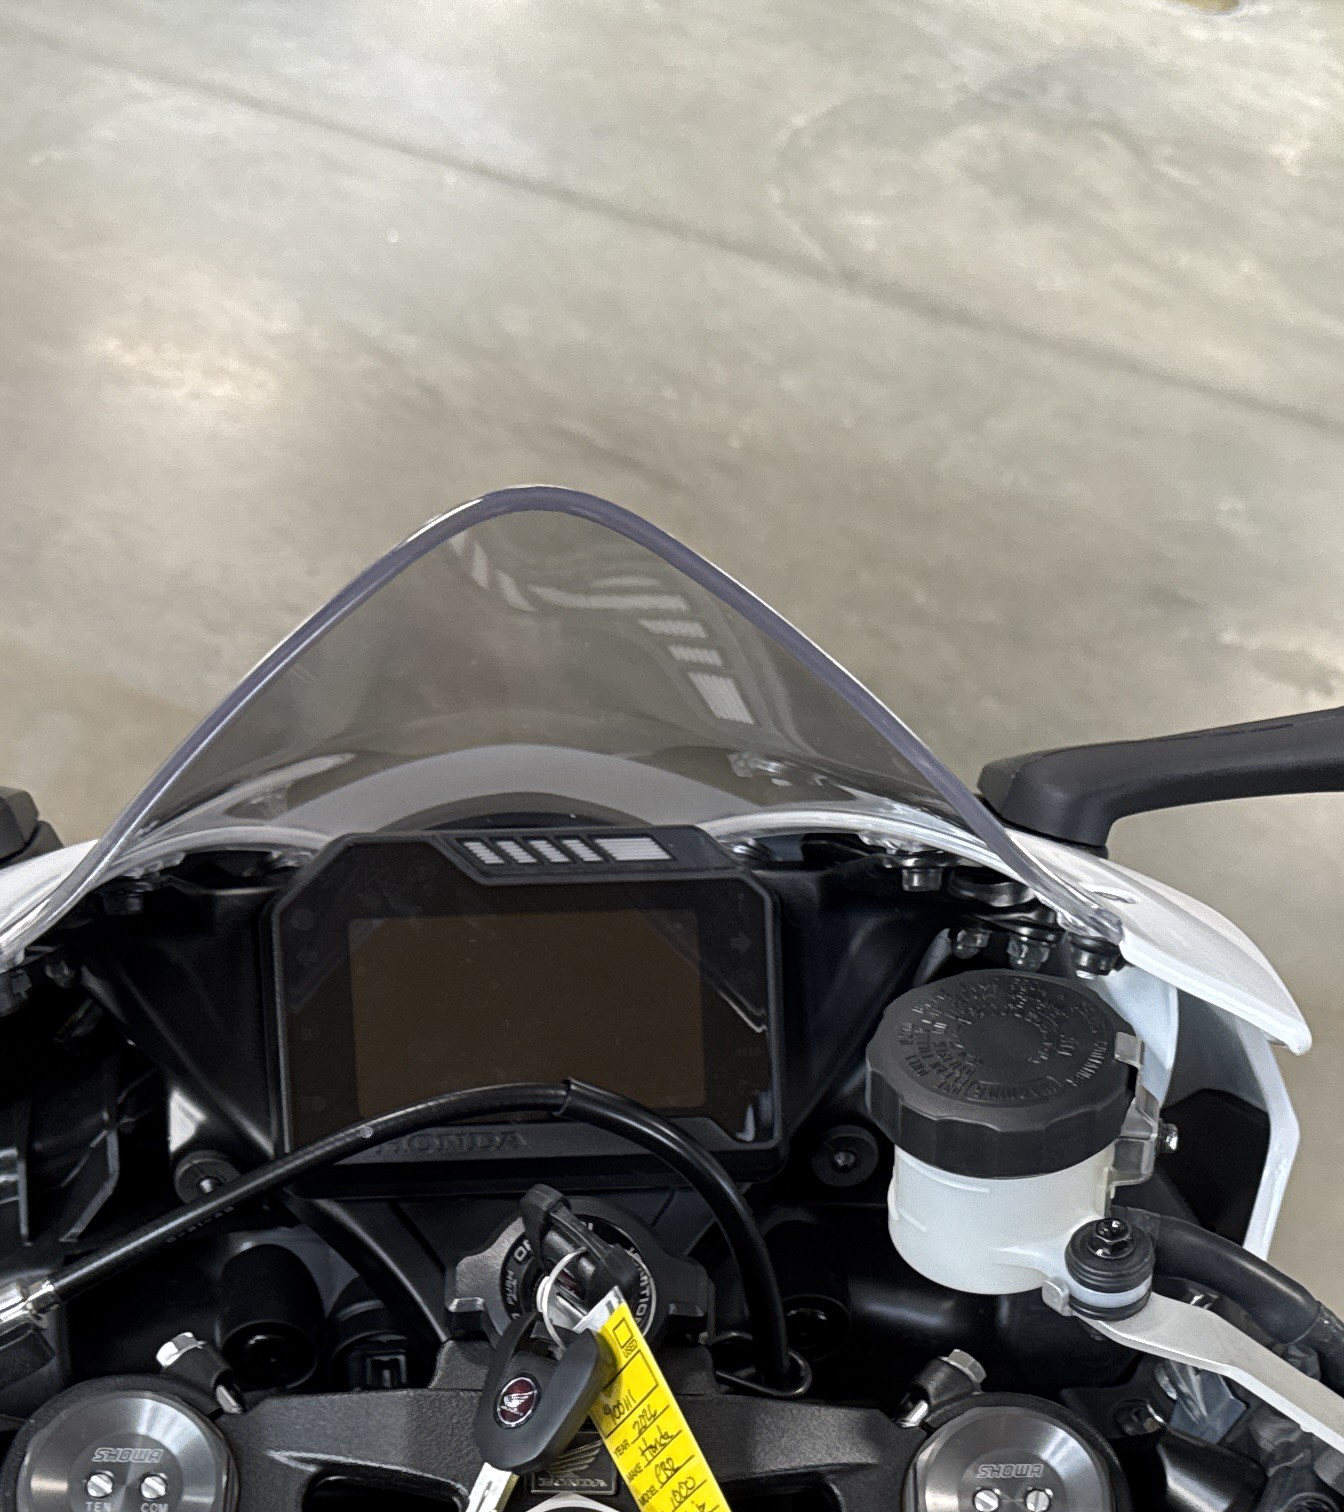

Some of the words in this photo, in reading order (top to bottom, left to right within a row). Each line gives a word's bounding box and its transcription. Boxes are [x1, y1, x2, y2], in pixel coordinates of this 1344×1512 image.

[92, 1447, 164, 1463] SHOWA
[613, 1438, 631, 1457] YEAR
[976, 1463, 1044, 1478] SHOWA
[86, 1501, 112, 1512] TEN
